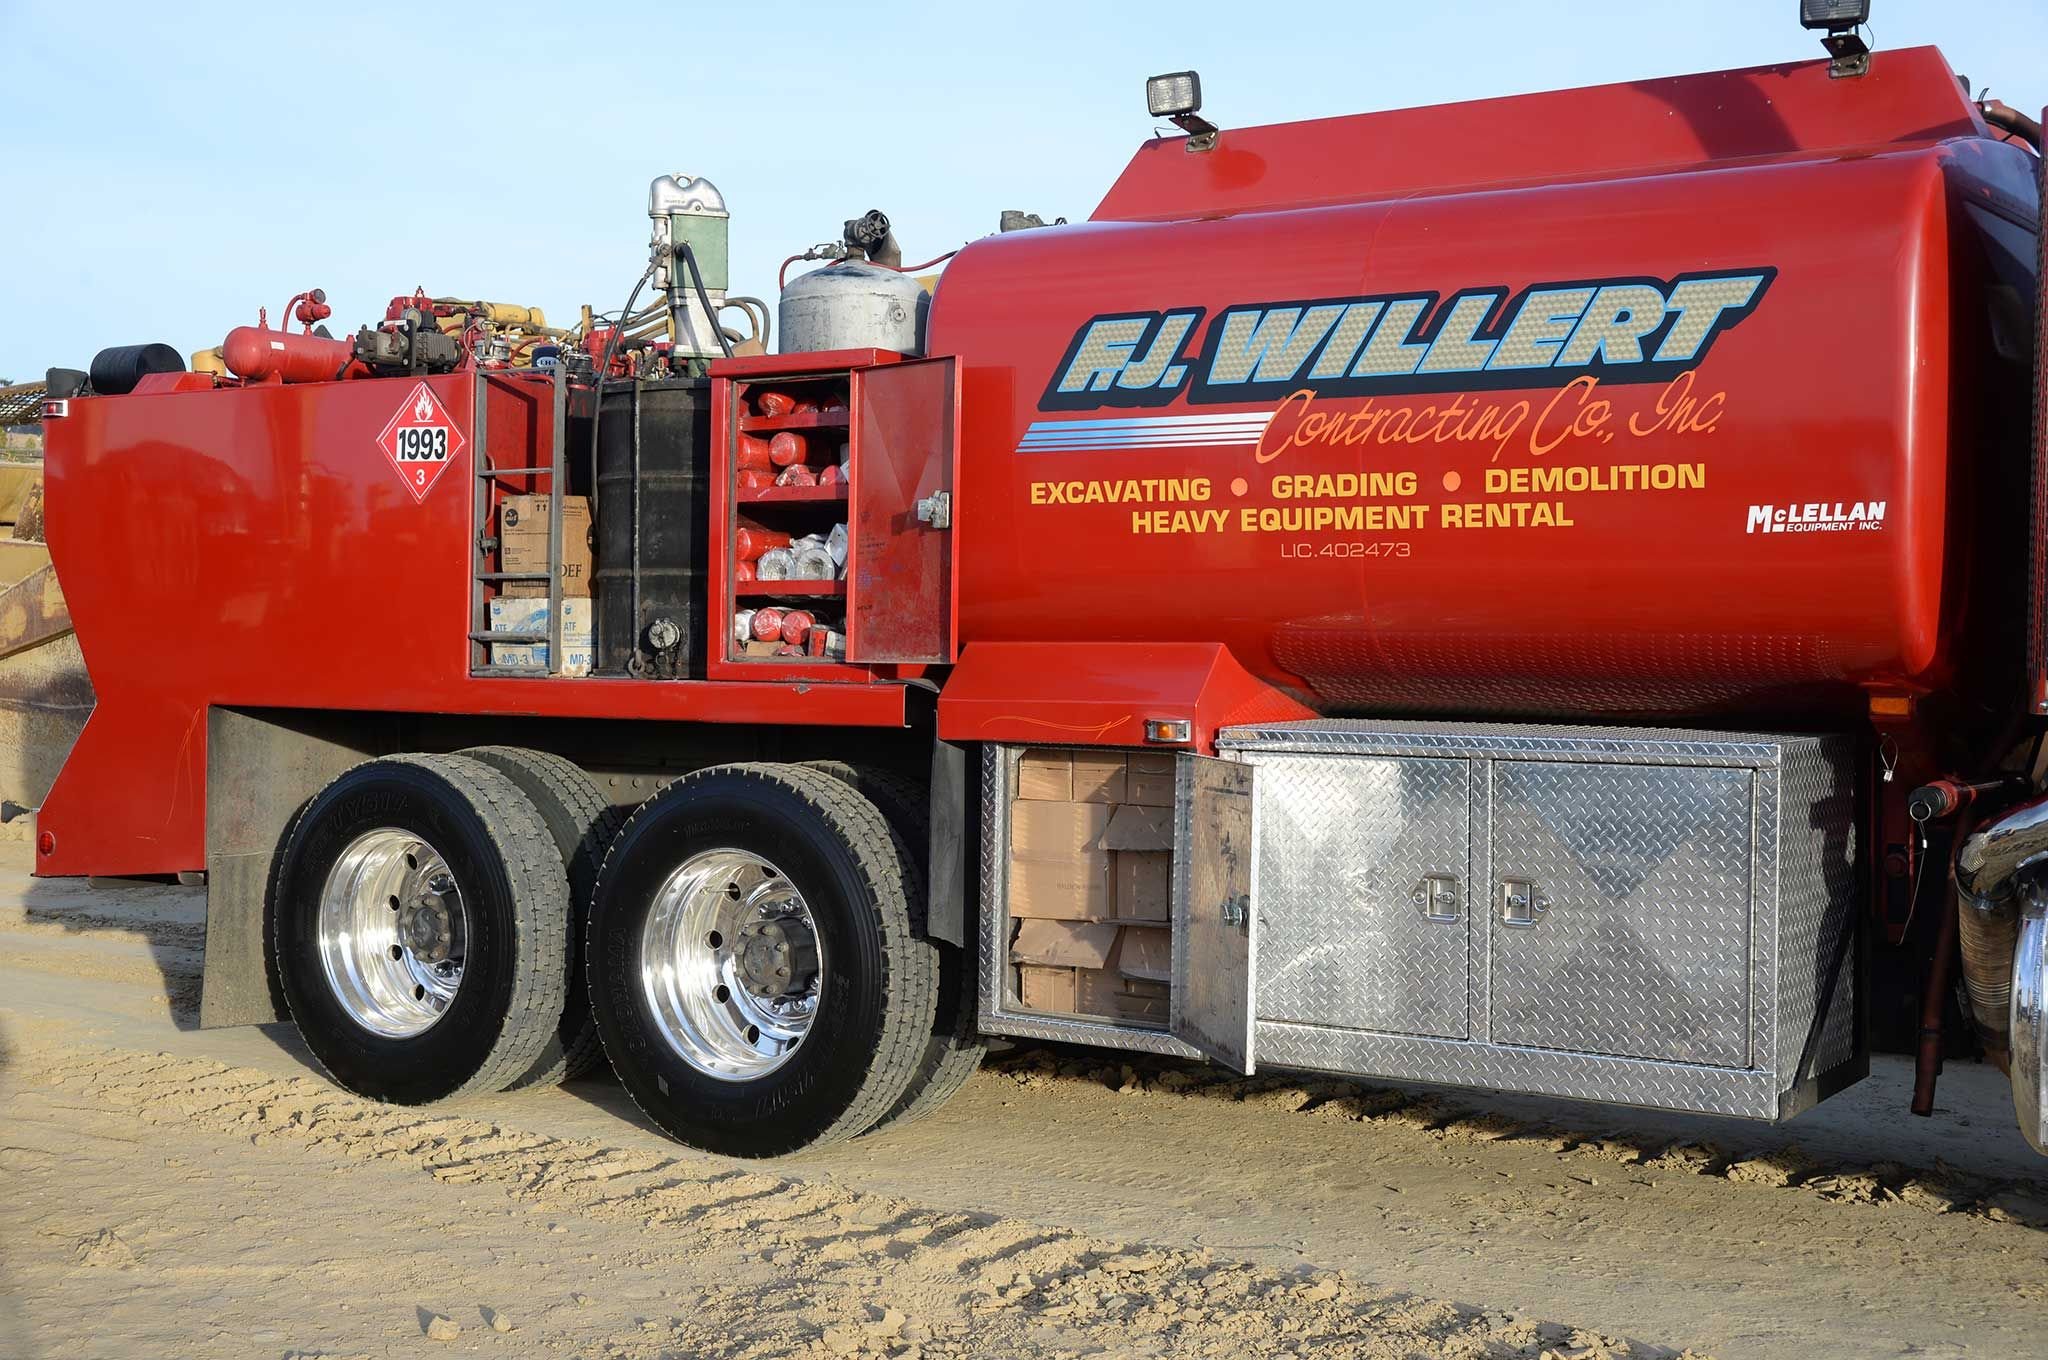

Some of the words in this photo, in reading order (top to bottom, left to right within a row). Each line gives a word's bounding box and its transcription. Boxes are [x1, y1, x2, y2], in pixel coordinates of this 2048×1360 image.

[1056, 313, 1196, 392] F.J.
[1206, 275, 1764, 385] WILLERT
[1256, 389, 1529, 463] Contracting
[1628, 370, 1726, 434] Inc.
[398, 428, 447, 460] 1993
[415, 468, 426, 486] 3
[1030, 478, 1211, 505] EXCAVATING
[1271, 471, 1417, 499] GRADING
[1484, 463, 1706, 495] DEMOLITION
[1132, 509, 1229, 534] HEAVY
[1240, 505, 1430, 533] EQUIPMENT
[1440, 502, 1574, 529] RENTAL
[1786, 521, 1855, 532] EQUIPMENT
[1858, 521, 1883, 531] INC.
